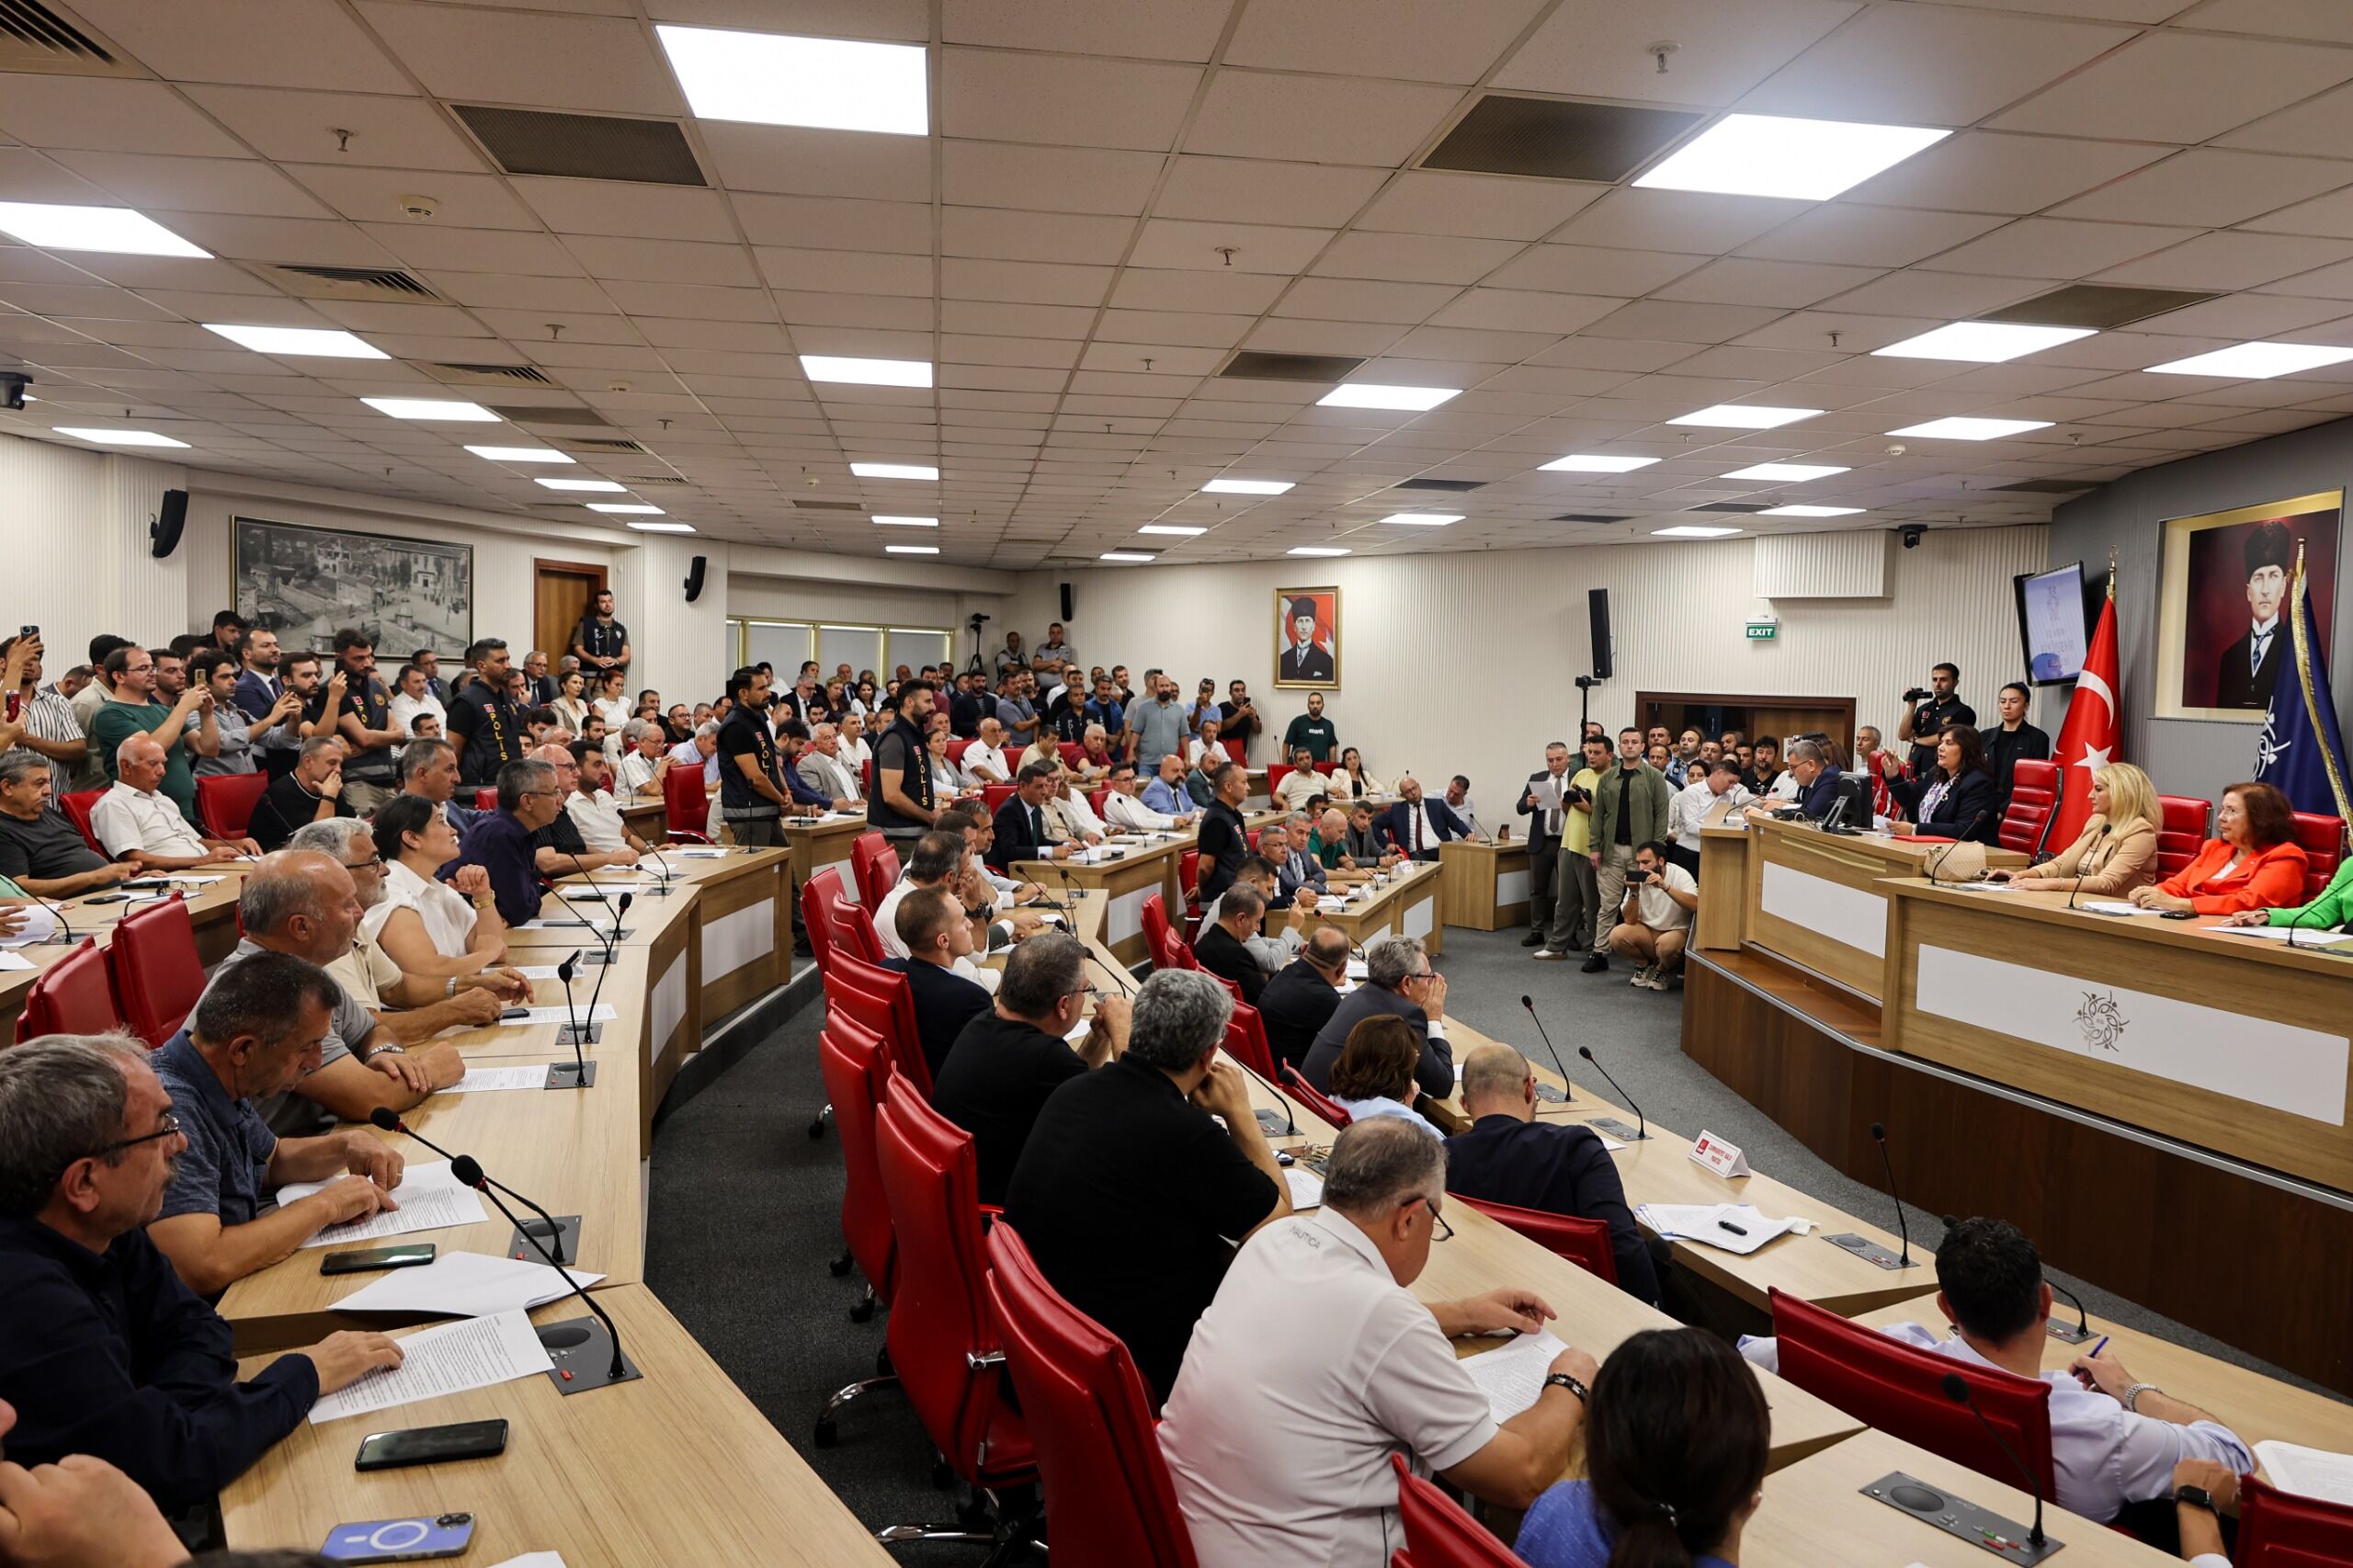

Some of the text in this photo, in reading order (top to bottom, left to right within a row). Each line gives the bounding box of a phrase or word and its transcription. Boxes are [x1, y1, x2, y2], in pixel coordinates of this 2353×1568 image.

[1748, 628, 1773, 636] EXIT
[489, 712, 508, 761] POLİS
[917, 755, 928, 806] POLİS
[1290, 1225, 1321, 1249] NAUTICA
